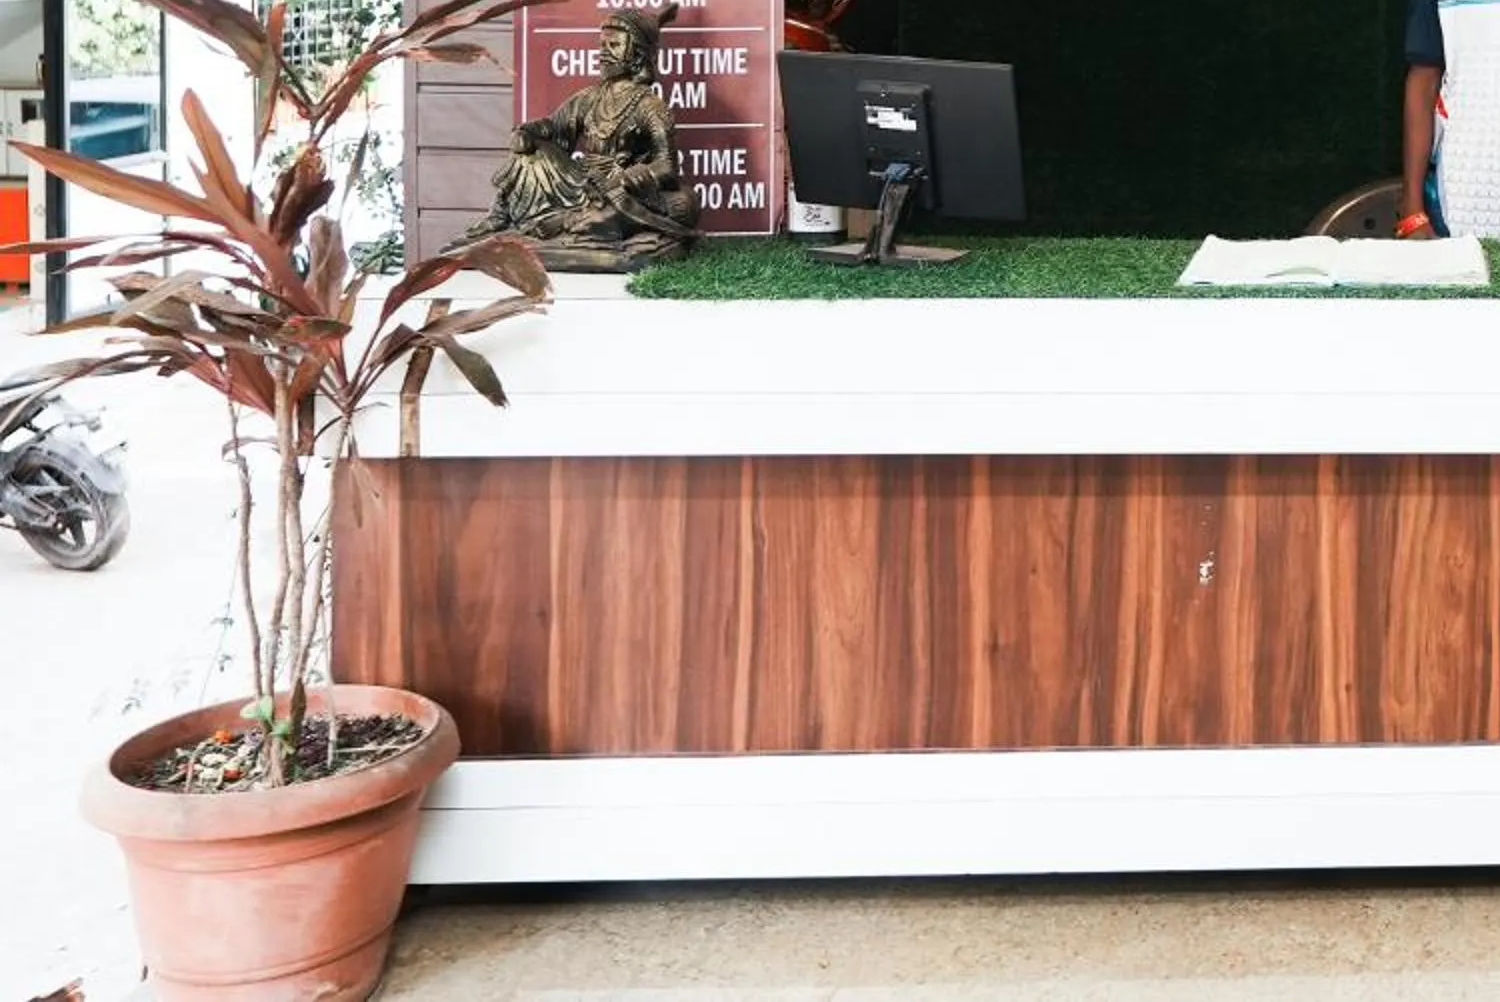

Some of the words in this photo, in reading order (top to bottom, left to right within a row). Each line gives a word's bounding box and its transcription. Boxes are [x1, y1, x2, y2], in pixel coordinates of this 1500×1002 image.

[551, 49, 601, 76] CHE
[657, 49, 689, 75] UT
[691, 48, 747, 75] TIME
[669, 82, 706, 109] AM
[690, 149, 747, 176] TIME
[727, 181, 765, 209] AM
